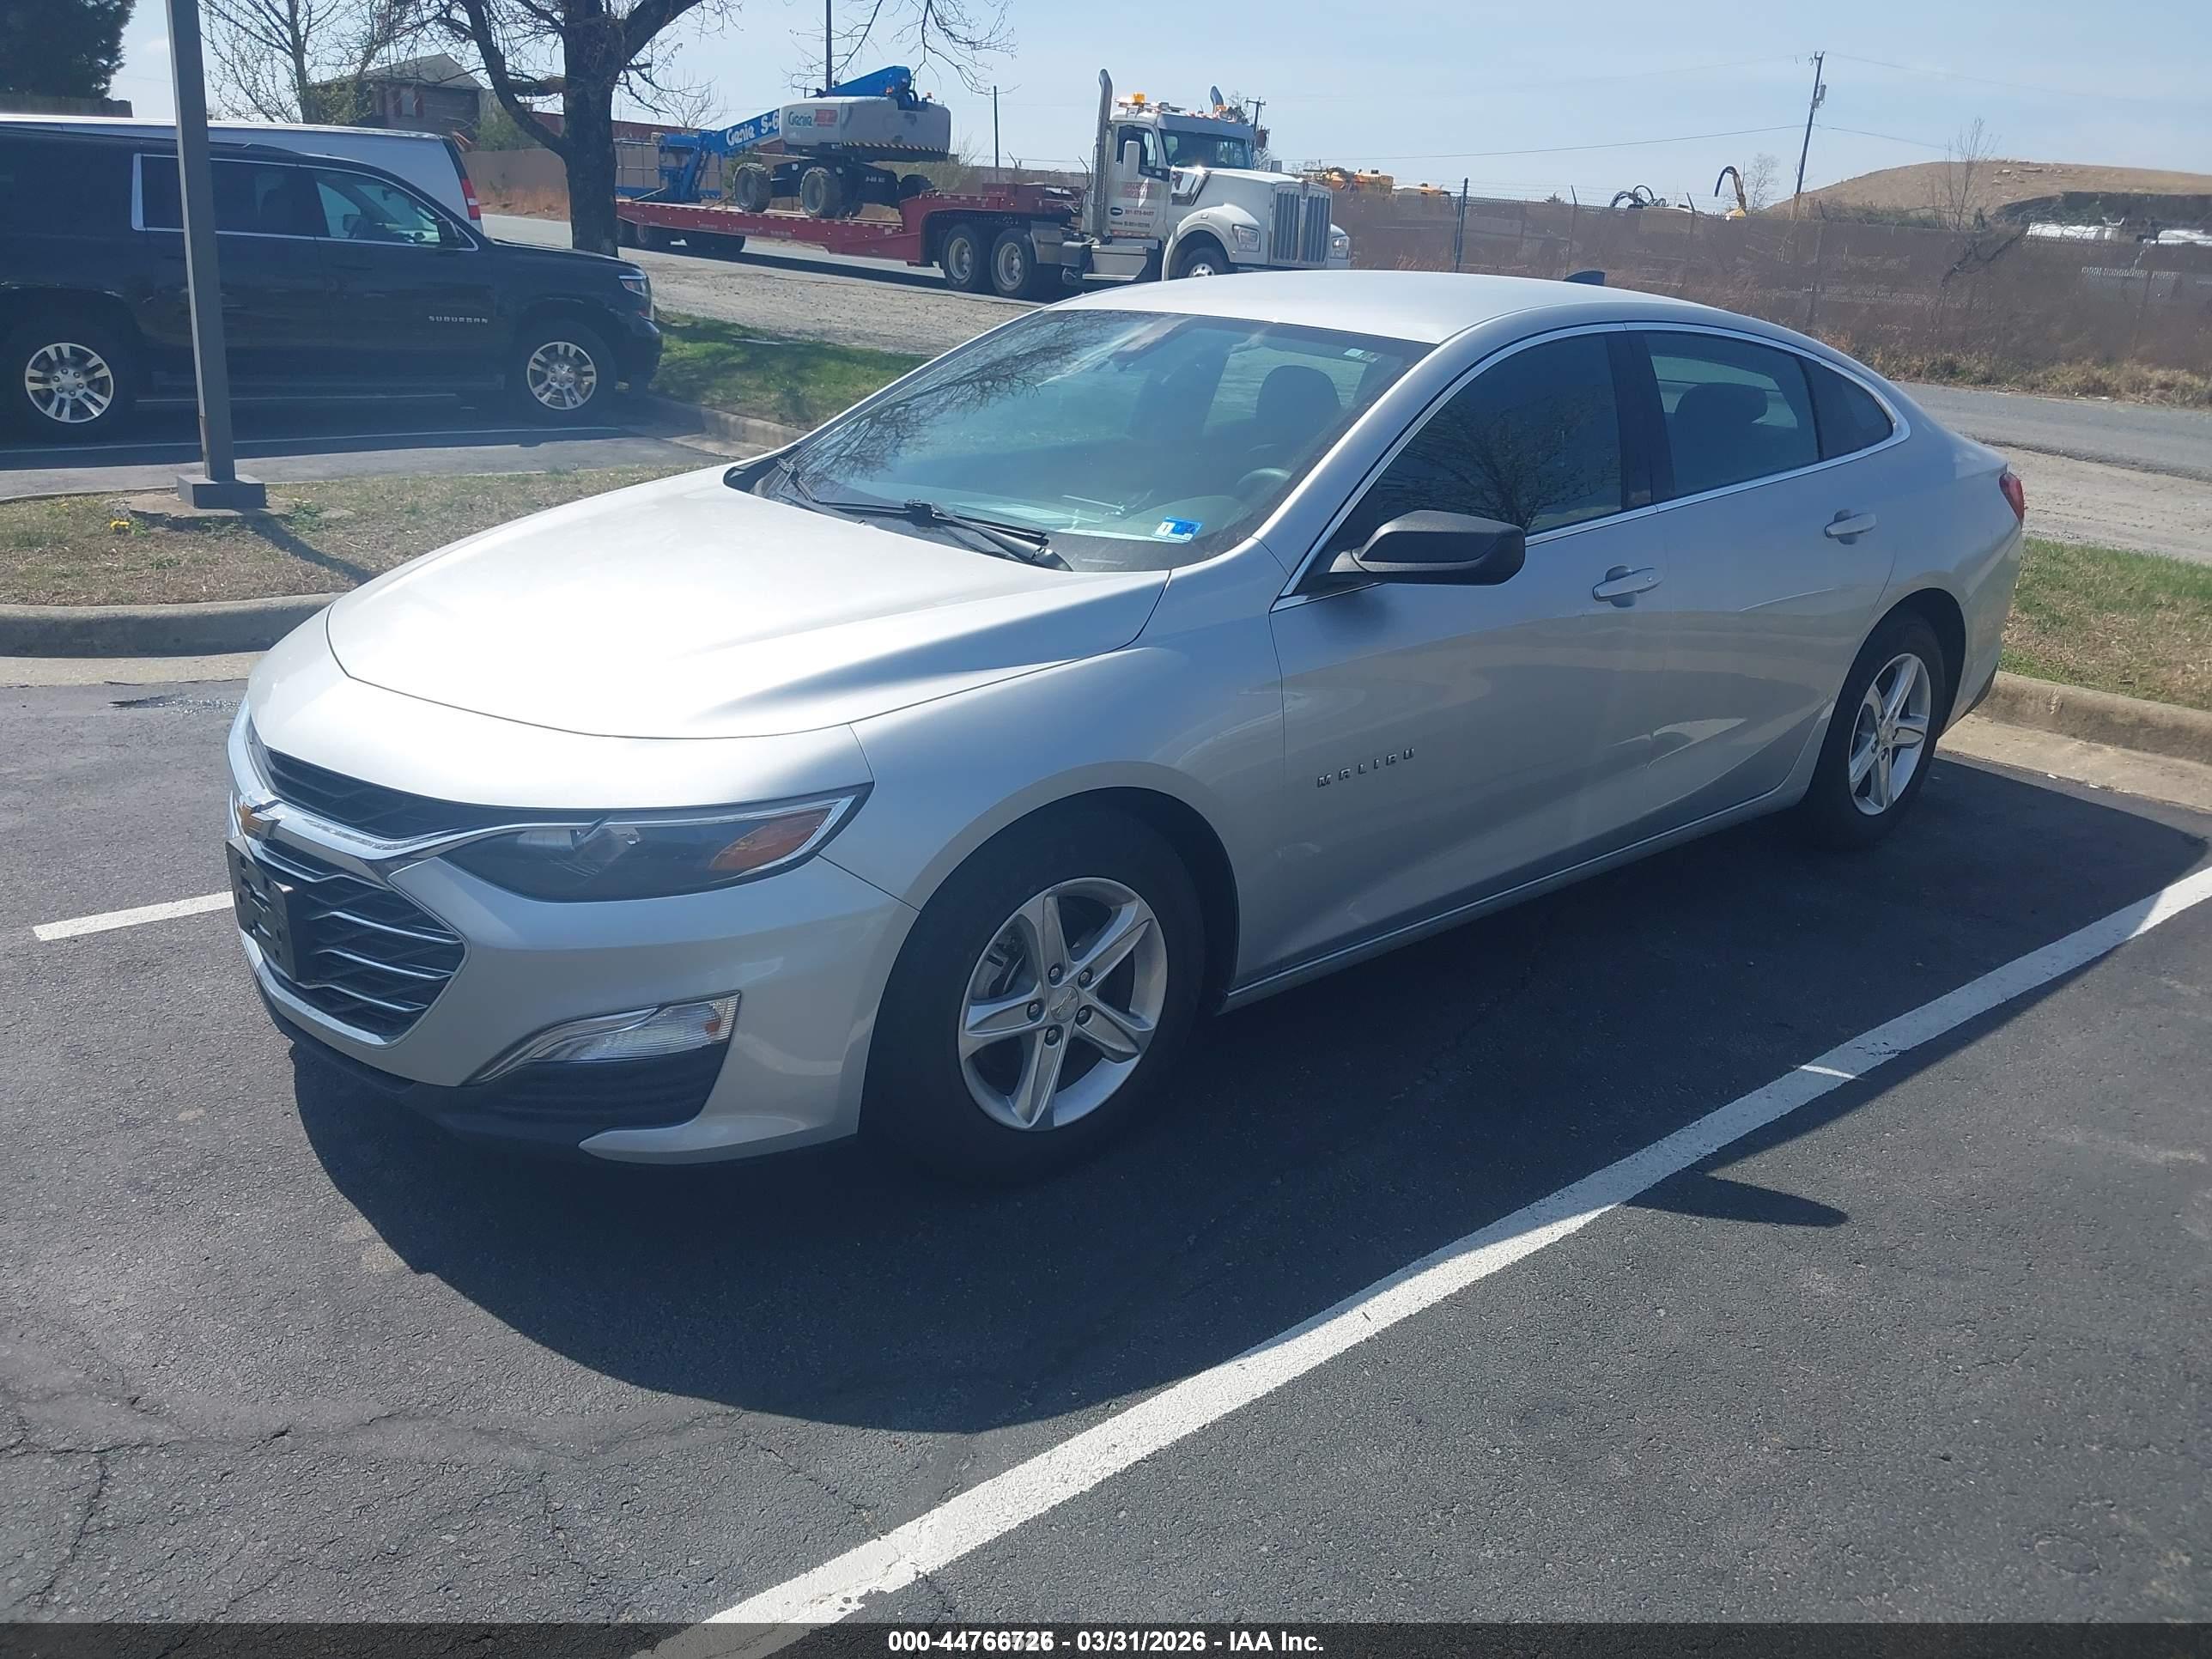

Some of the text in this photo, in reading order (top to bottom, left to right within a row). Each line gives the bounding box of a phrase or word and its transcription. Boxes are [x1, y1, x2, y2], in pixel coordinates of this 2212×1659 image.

[787, 111, 813, 126] Genie
[726, 124, 756, 147] Genie
[428, 315, 489, 324] SUBURBAN
[1316, 747, 1415, 788] MALIBU
